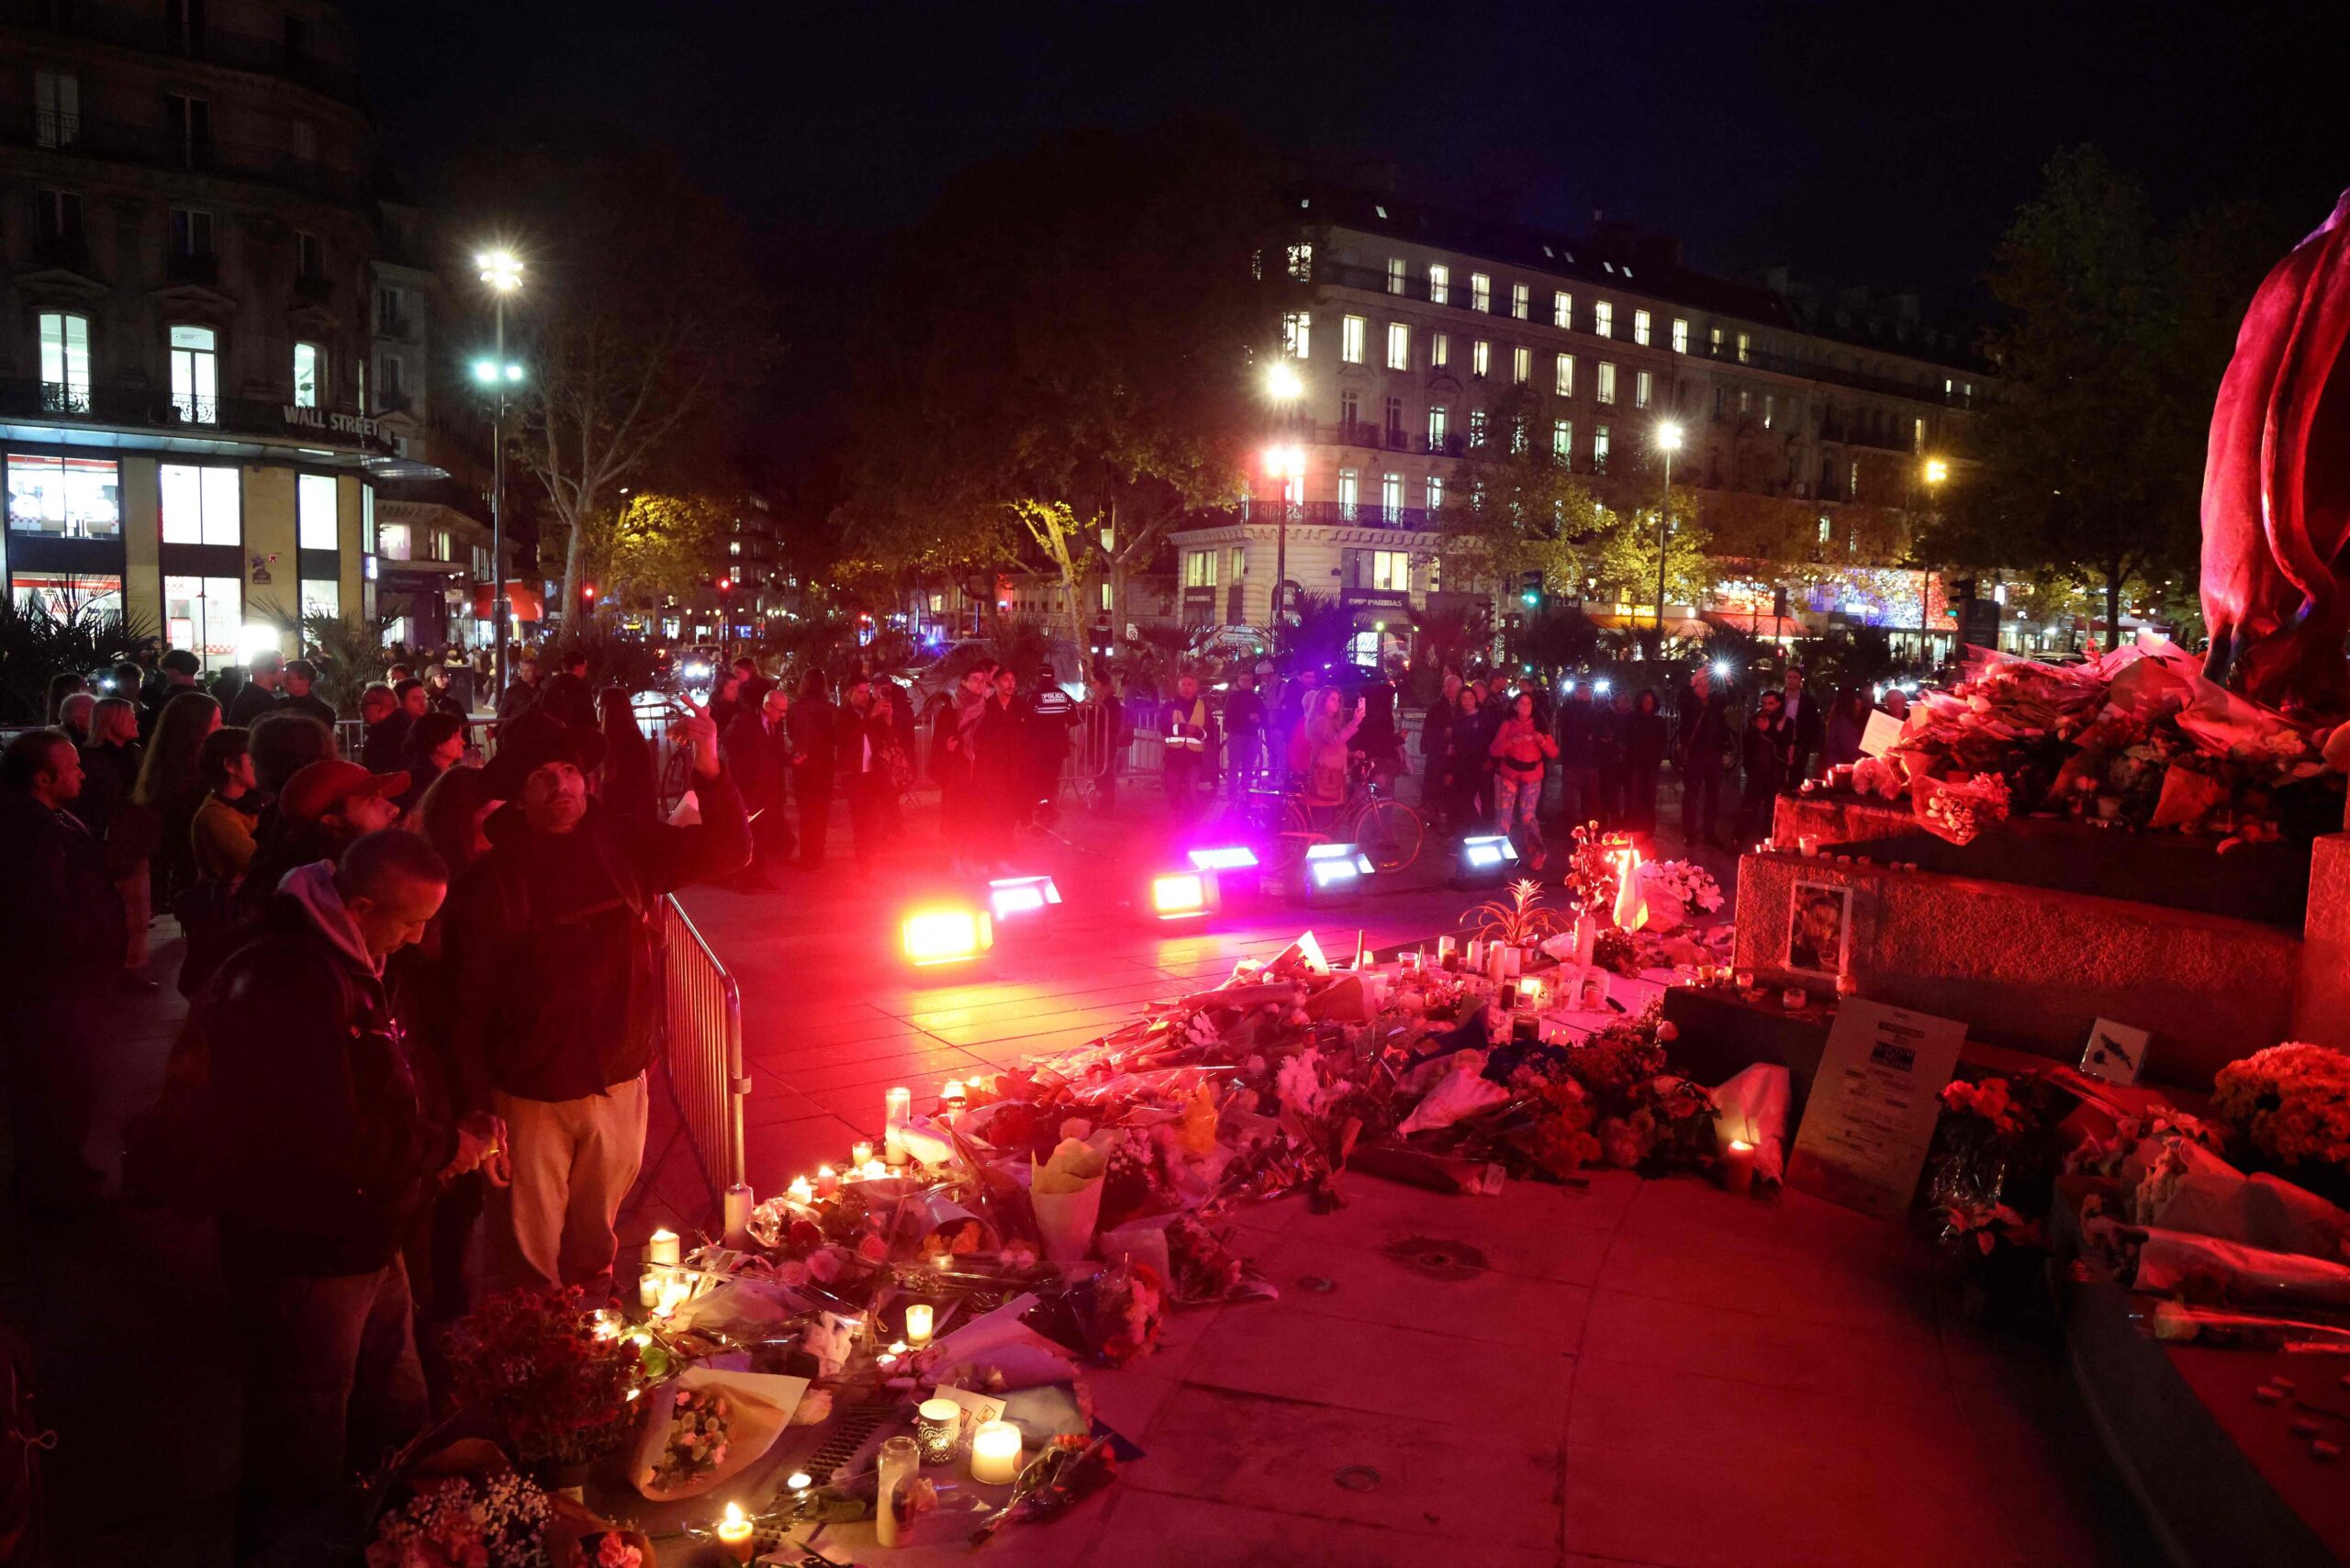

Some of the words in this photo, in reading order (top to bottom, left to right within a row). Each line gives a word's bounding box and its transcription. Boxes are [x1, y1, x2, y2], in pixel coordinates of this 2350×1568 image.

[284, 405, 326, 429] WALL
[330, 412, 379, 436] STREET
[1368, 599, 1403, 607] PARIBAS
